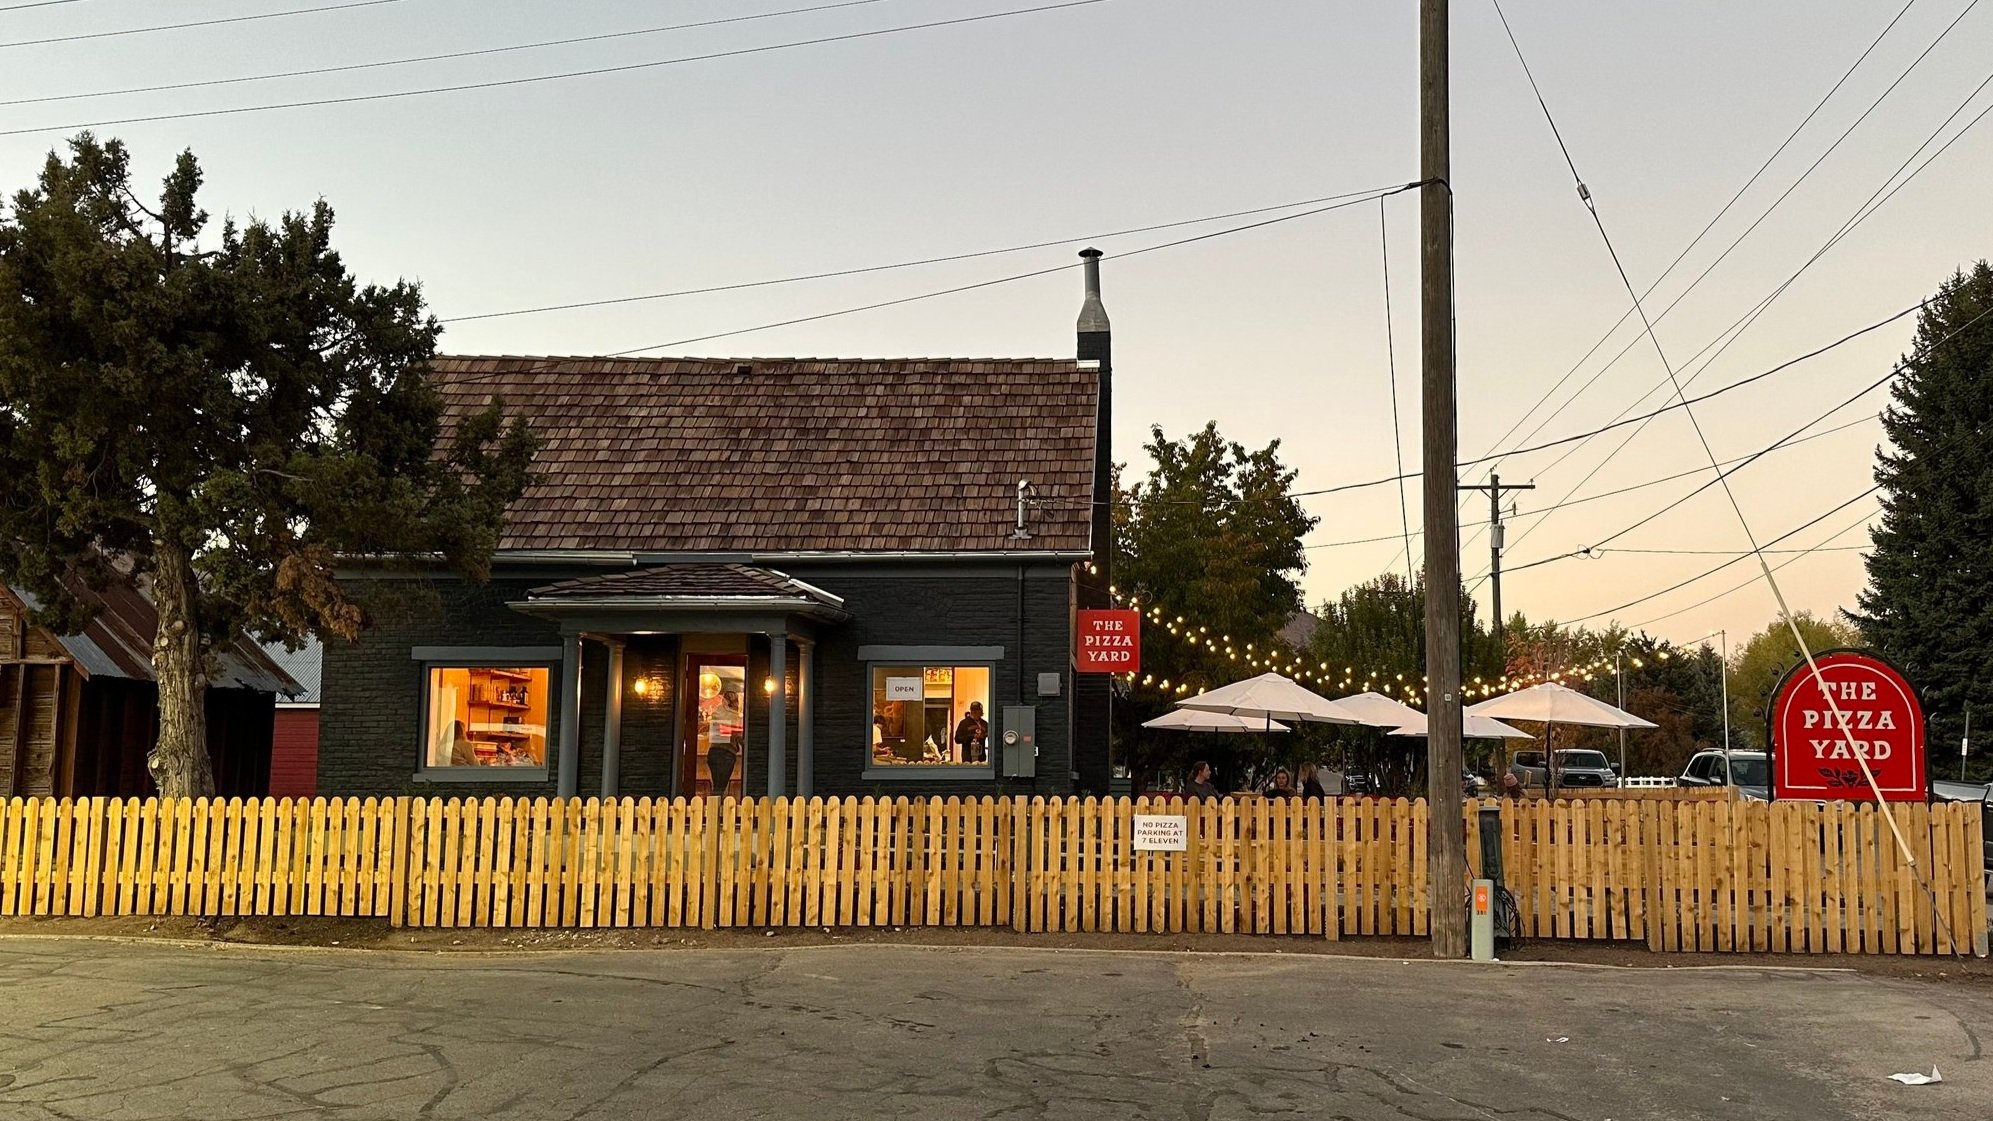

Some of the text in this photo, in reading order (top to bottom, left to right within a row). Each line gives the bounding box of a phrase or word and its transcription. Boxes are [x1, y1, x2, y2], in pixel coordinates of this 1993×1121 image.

[1093, 620, 1123, 631] THE
[1084, 635, 1133, 646] PIZZA
[1087, 651, 1130, 662] YARD
[1818, 682, 1876, 700] THE
[1802, 710, 1896, 730] PIZZA
[1809, 739, 1892, 760] YARD
